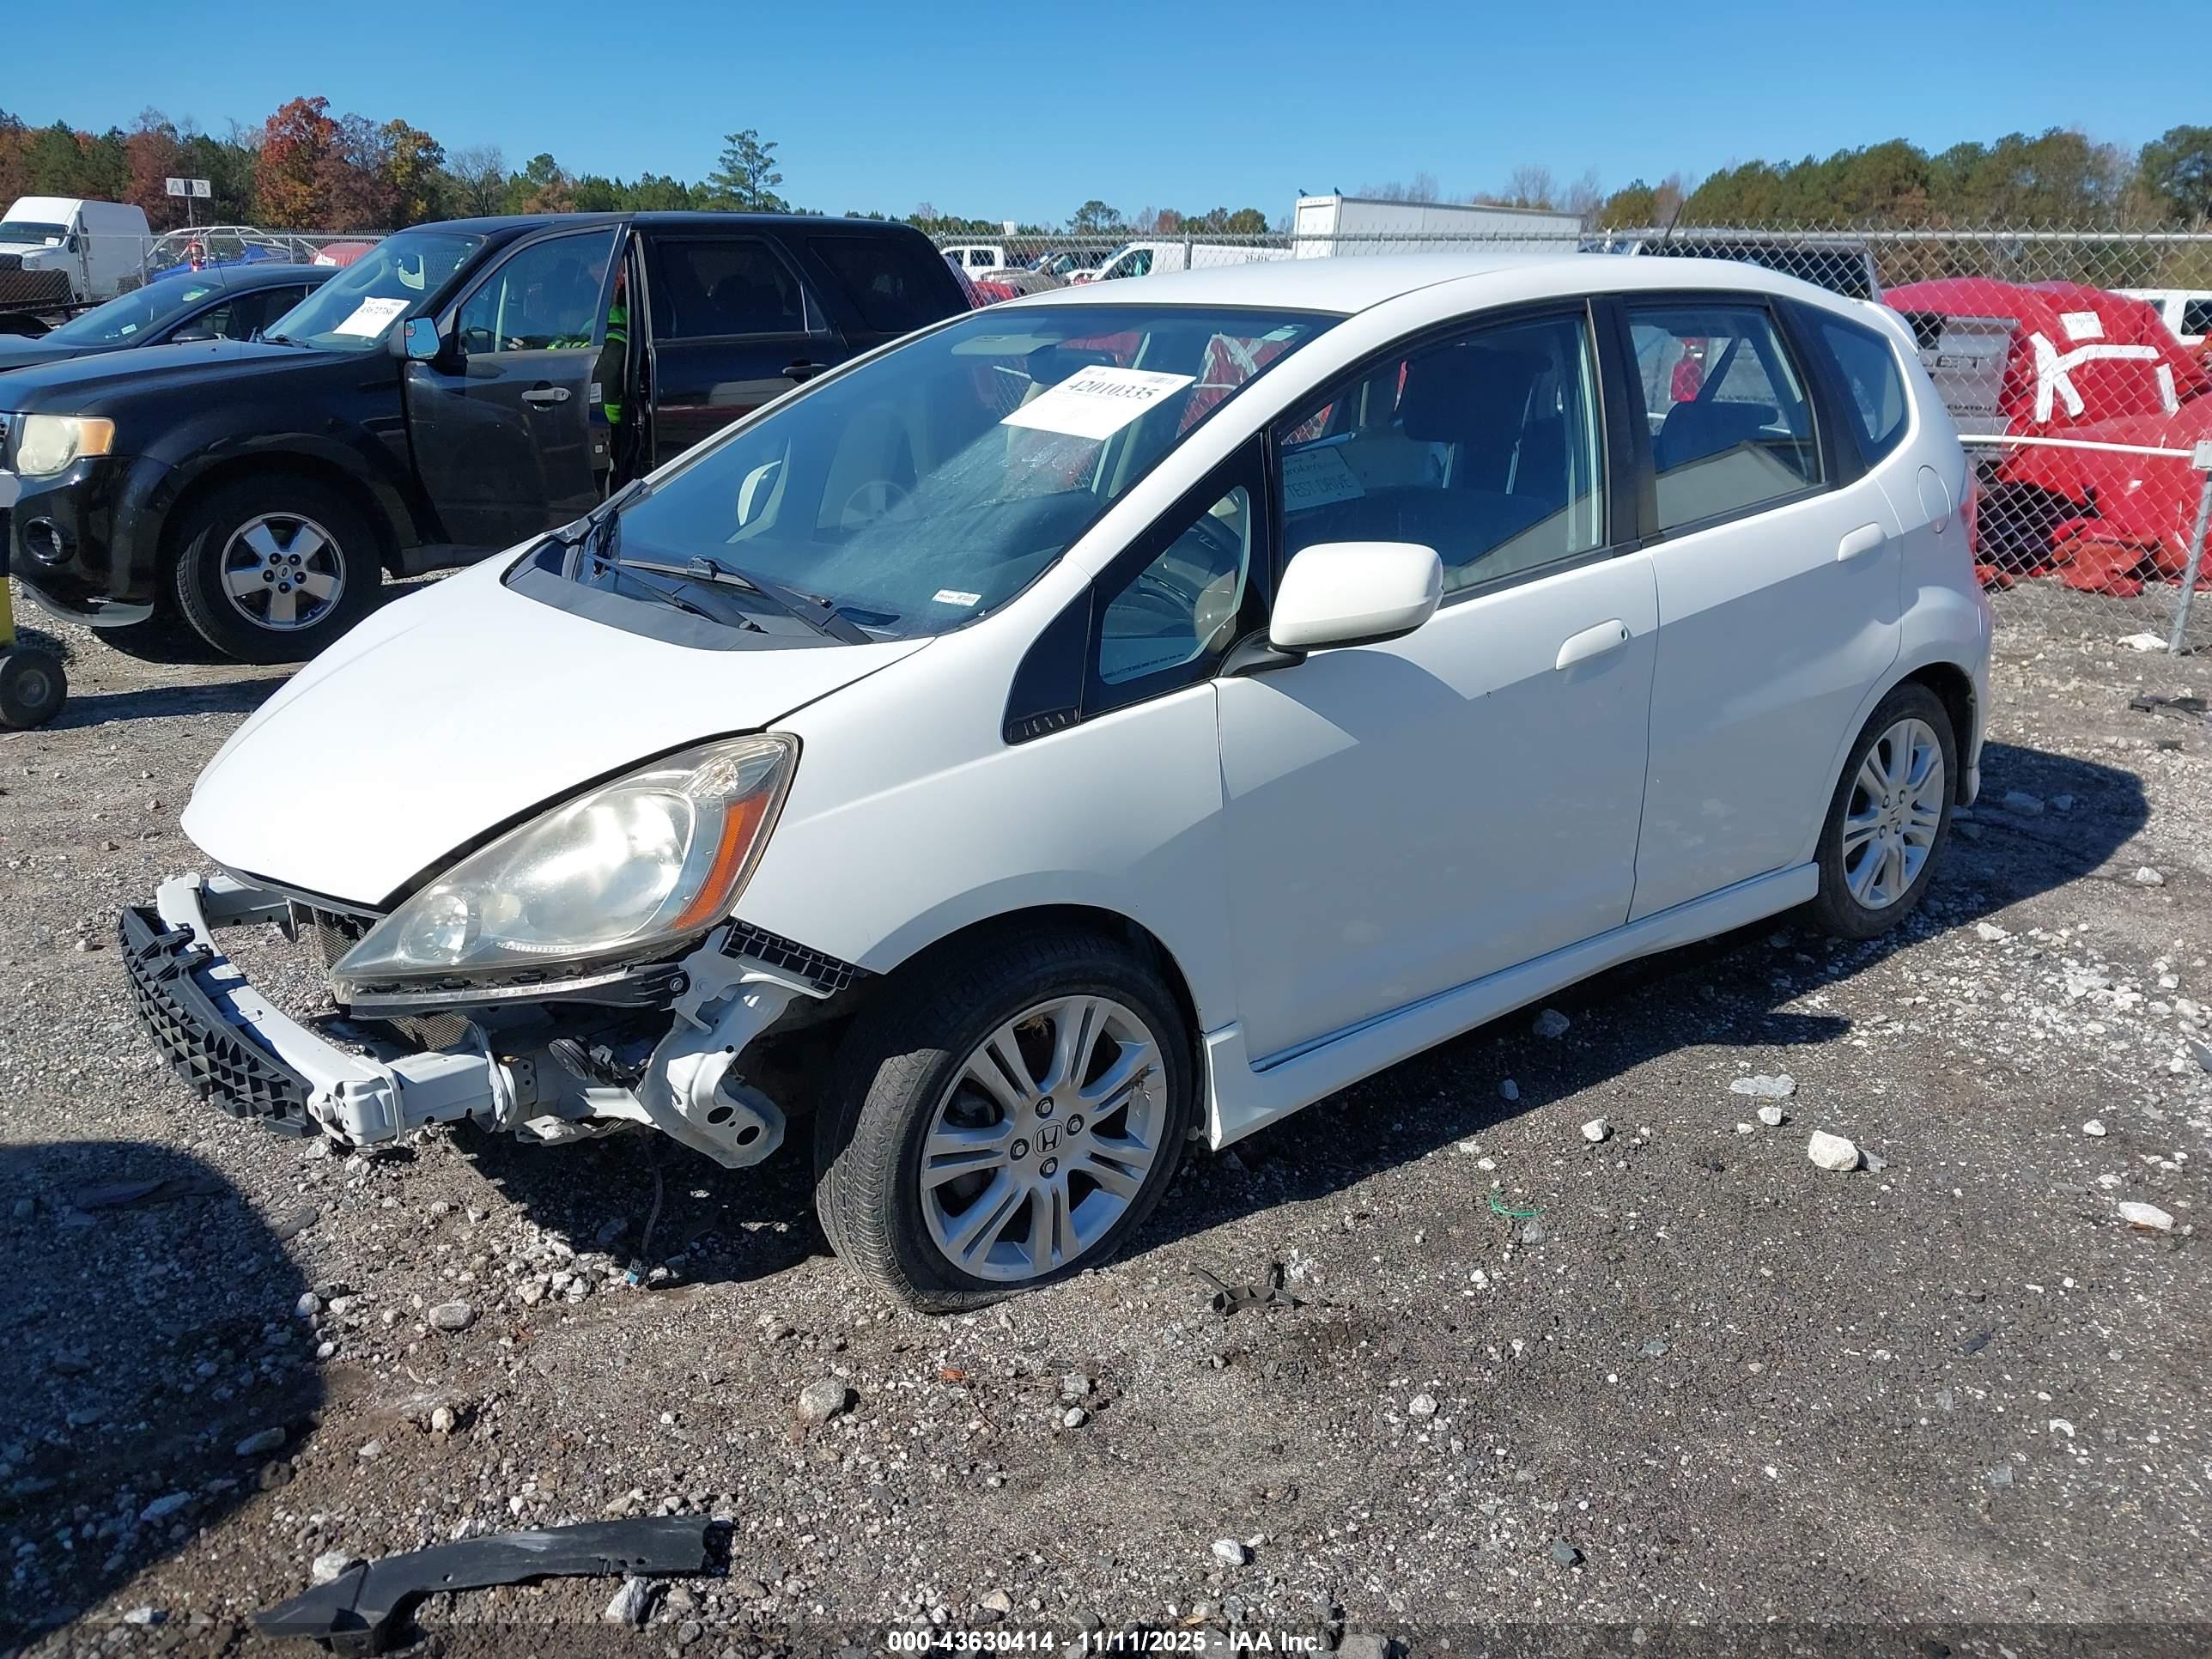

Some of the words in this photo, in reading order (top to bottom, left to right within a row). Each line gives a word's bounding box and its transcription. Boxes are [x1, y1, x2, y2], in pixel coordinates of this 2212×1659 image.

[169, 180, 183, 193] A
[197, 181, 207, 195] B
[1068, 379, 1160, 399] 42010335
[1285, 481, 1316, 498] TEST
[1316, 473, 1353, 493] DRIVE
